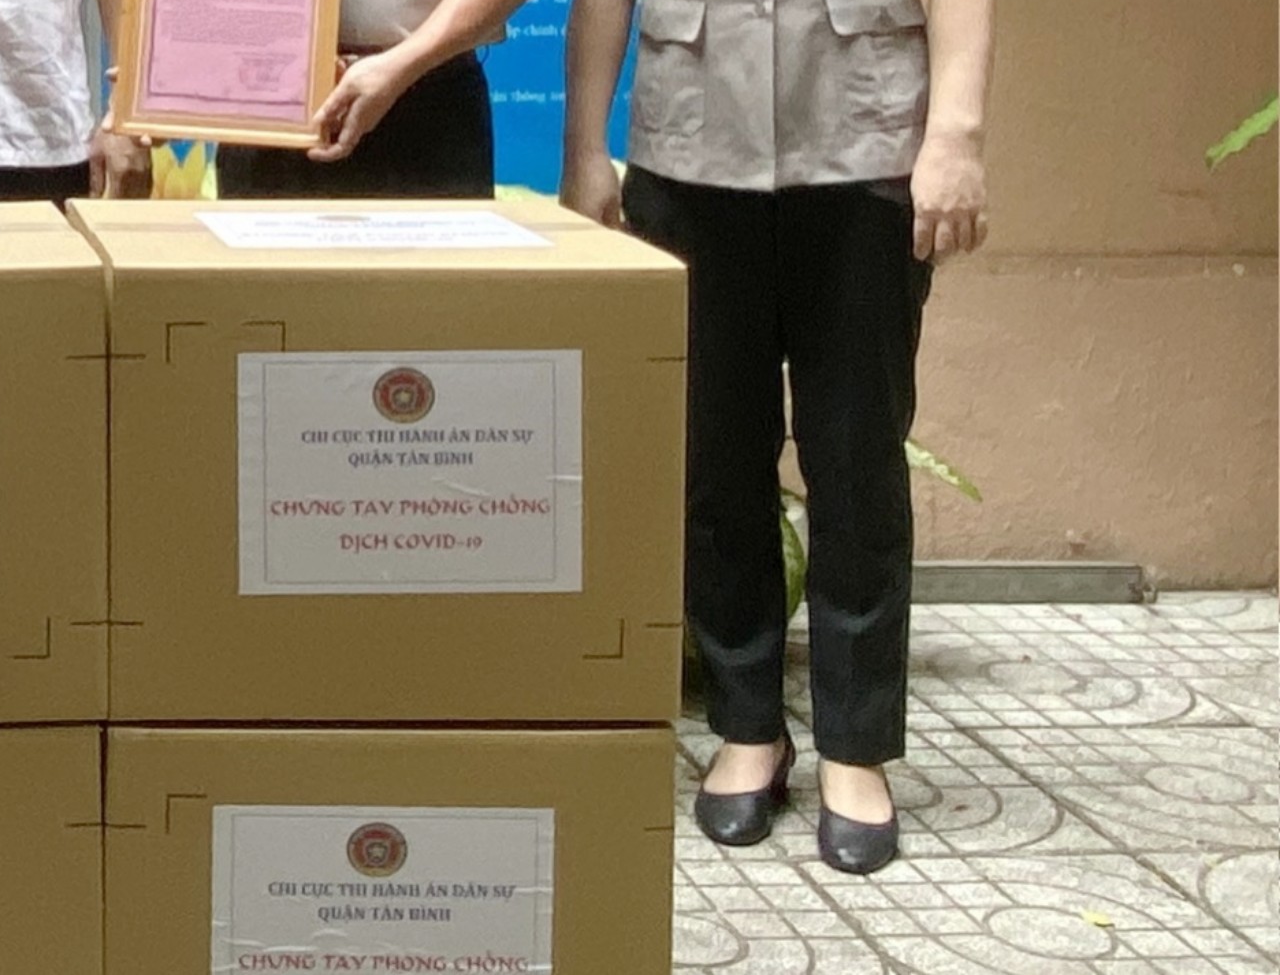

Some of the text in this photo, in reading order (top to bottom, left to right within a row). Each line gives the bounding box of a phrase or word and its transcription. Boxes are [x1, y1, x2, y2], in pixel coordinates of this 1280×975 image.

[300, 429, 329, 444] CHI
[330, 429, 364, 444] CỤC
[364, 429, 396, 444] THI
[447, 428, 471, 443] ÁN
[474, 428, 509, 442] DÂN
[511, 429, 534, 444] SỰ
[347, 449, 394, 468] QUẬN
[395, 450, 430, 466] TÂN
[351, 499, 394, 515] TAY
[399, 498, 473, 516] PHÒNG
[478, 497, 551, 515] CHỐNG
[339, 532, 483, 554] DỊCH COVID-19
[267, 881, 297, 896] CHI
[300, 882, 334, 898] CỤC
[336, 882, 368, 897] THI
[424, 882, 448, 897] ÁN
[451, 883, 489, 898] DÂN
[491, 884, 517, 899] SỰ
[317, 904, 366, 923] QUẬN
[371, 905, 405, 921] TÂN
[321, 953, 367, 970] TAY
